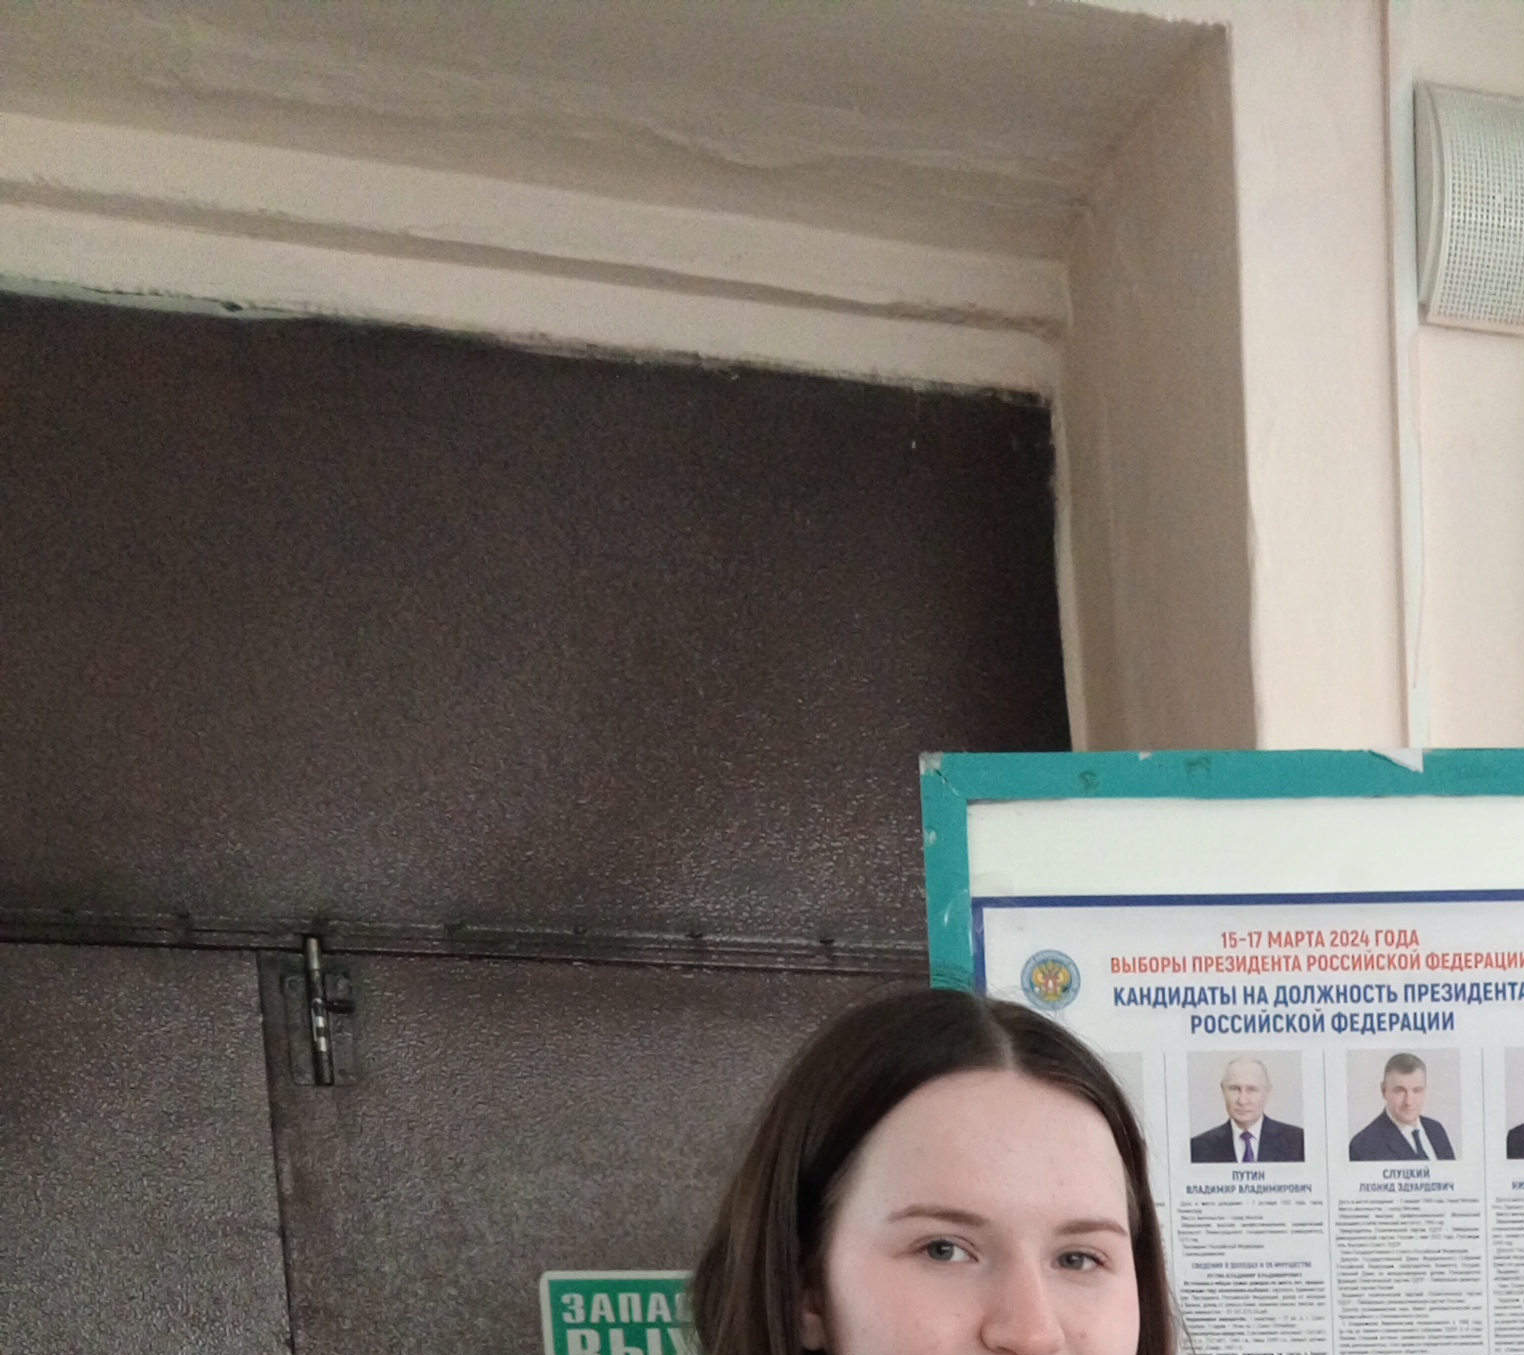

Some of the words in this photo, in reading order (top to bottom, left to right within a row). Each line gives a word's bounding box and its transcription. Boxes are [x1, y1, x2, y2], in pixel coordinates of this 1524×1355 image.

[1221, 931, 1262, 949] 15-17
[1268, 931, 1325, 949] МАРТА
[1330, 931, 1370, 947] 2024
[1375, 929, 1420, 949] ГОДА
[1111, 956, 1187, 973] ВЫБОРЫ
[1193, 955, 1302, 975] ПРЕЗИДЕНТА
[1307, 950, 1421, 972] РОССИЙСКОЙ
[1113, 986, 1236, 1009] КАНДИДАТЫ
[1243, 986, 1269, 1005] НА
[1273, 984, 1398, 1007] ДОЛЖНОСТЬ
[1191, 1009, 1325, 1034] РОССИЙСКОЙ
[1331, 1011, 1455, 1035] ФЕДЕРАЦИИ
[1232, 1171, 1265, 1181] ПУТИН
[1382, 1168, 1430, 1180] СЛУЦКИЙ
[1186, 1185, 1236, 1195] ВЛАДИМИР
[1239, 1184, 1312, 1194] ВЛАДИМИРОВИЧ
[1360, 1182, 1396, 1192] ЛЕОНИД
